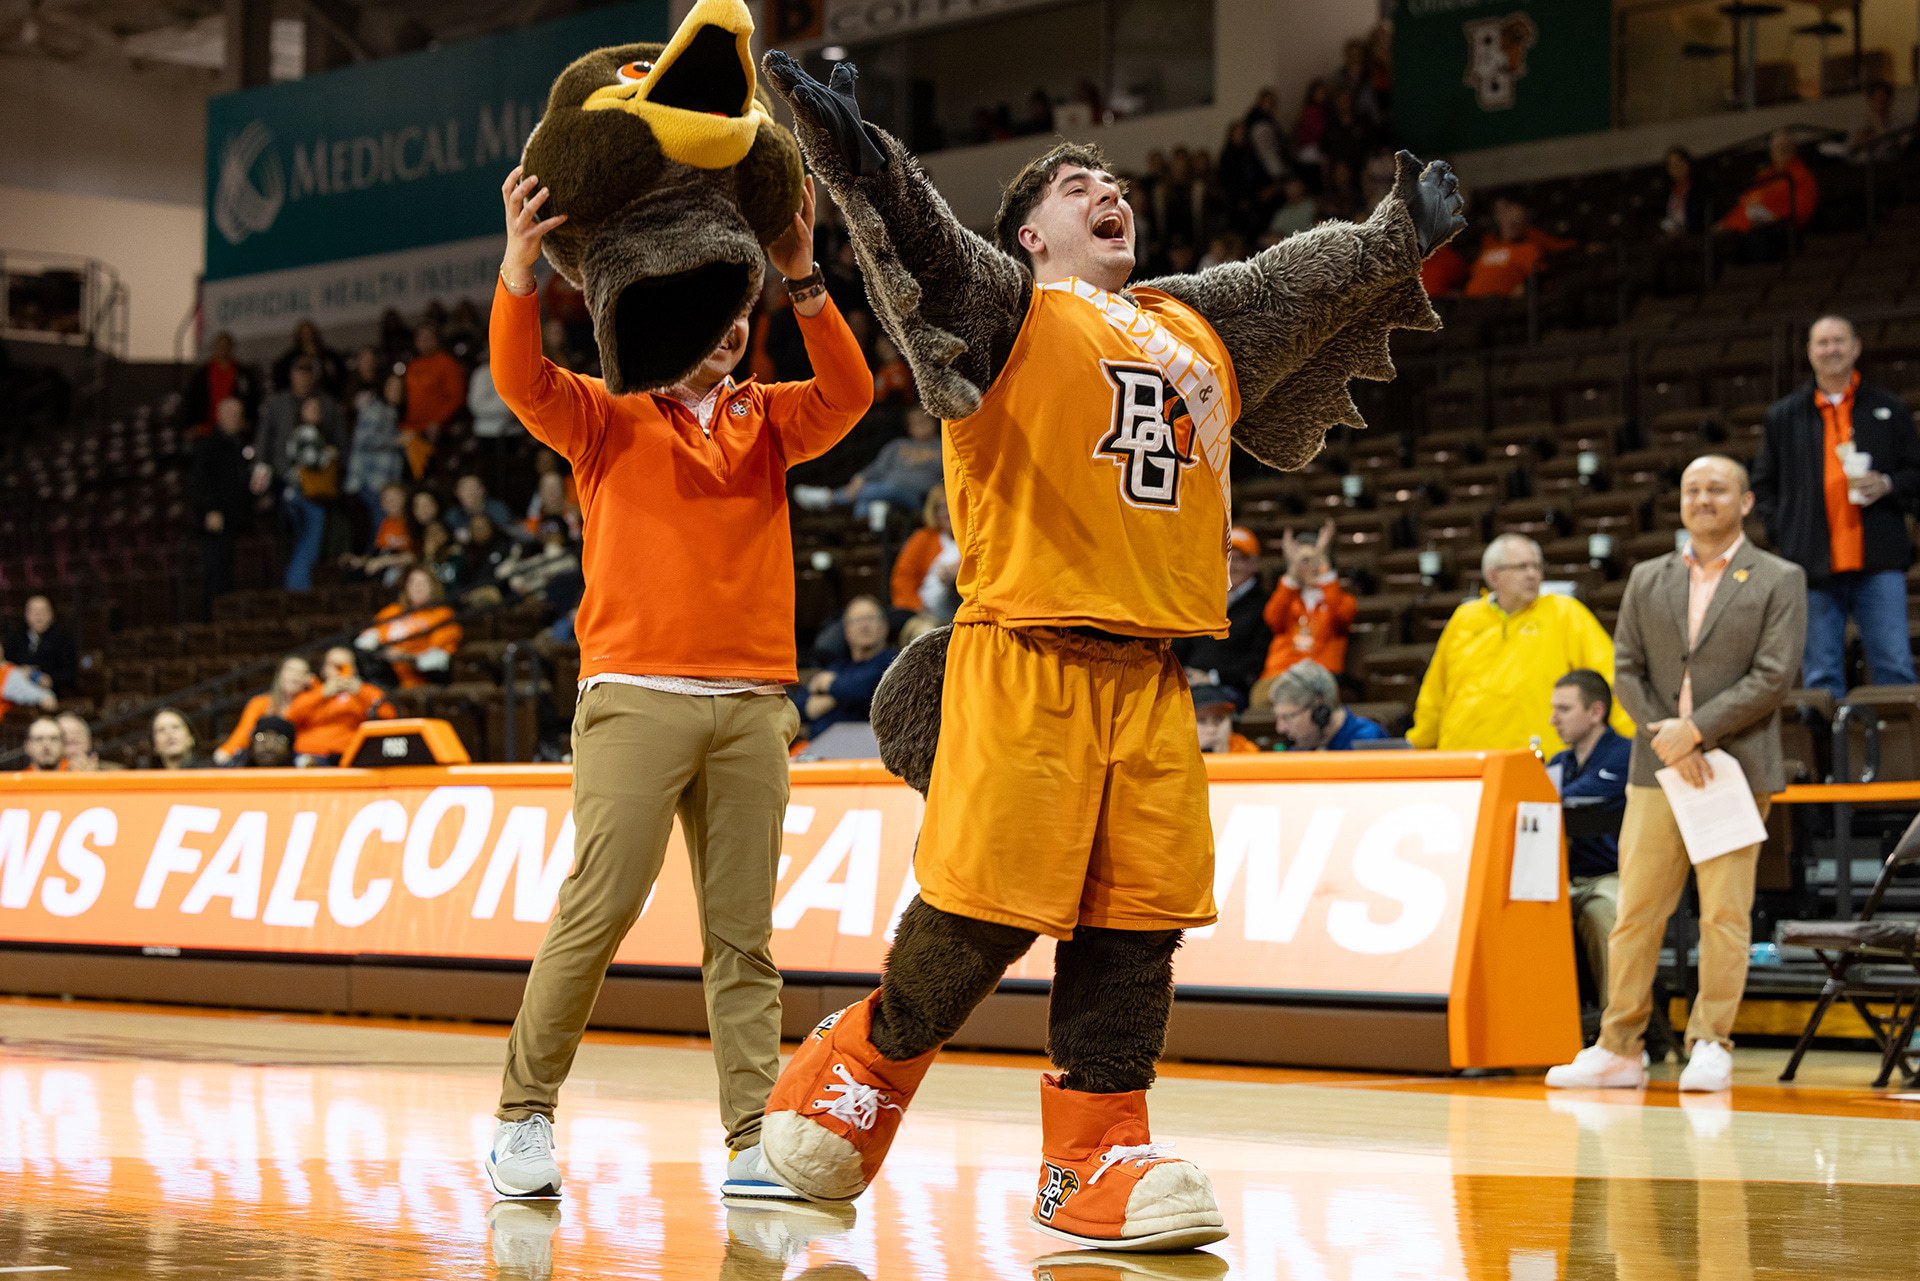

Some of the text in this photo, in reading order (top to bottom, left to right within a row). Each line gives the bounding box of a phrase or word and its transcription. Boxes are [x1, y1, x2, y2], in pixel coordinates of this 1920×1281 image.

[290, 119, 464, 199] MEDICAL
[1199, 385, 1213, 404] &
[134, 785, 657, 927] FALCON
